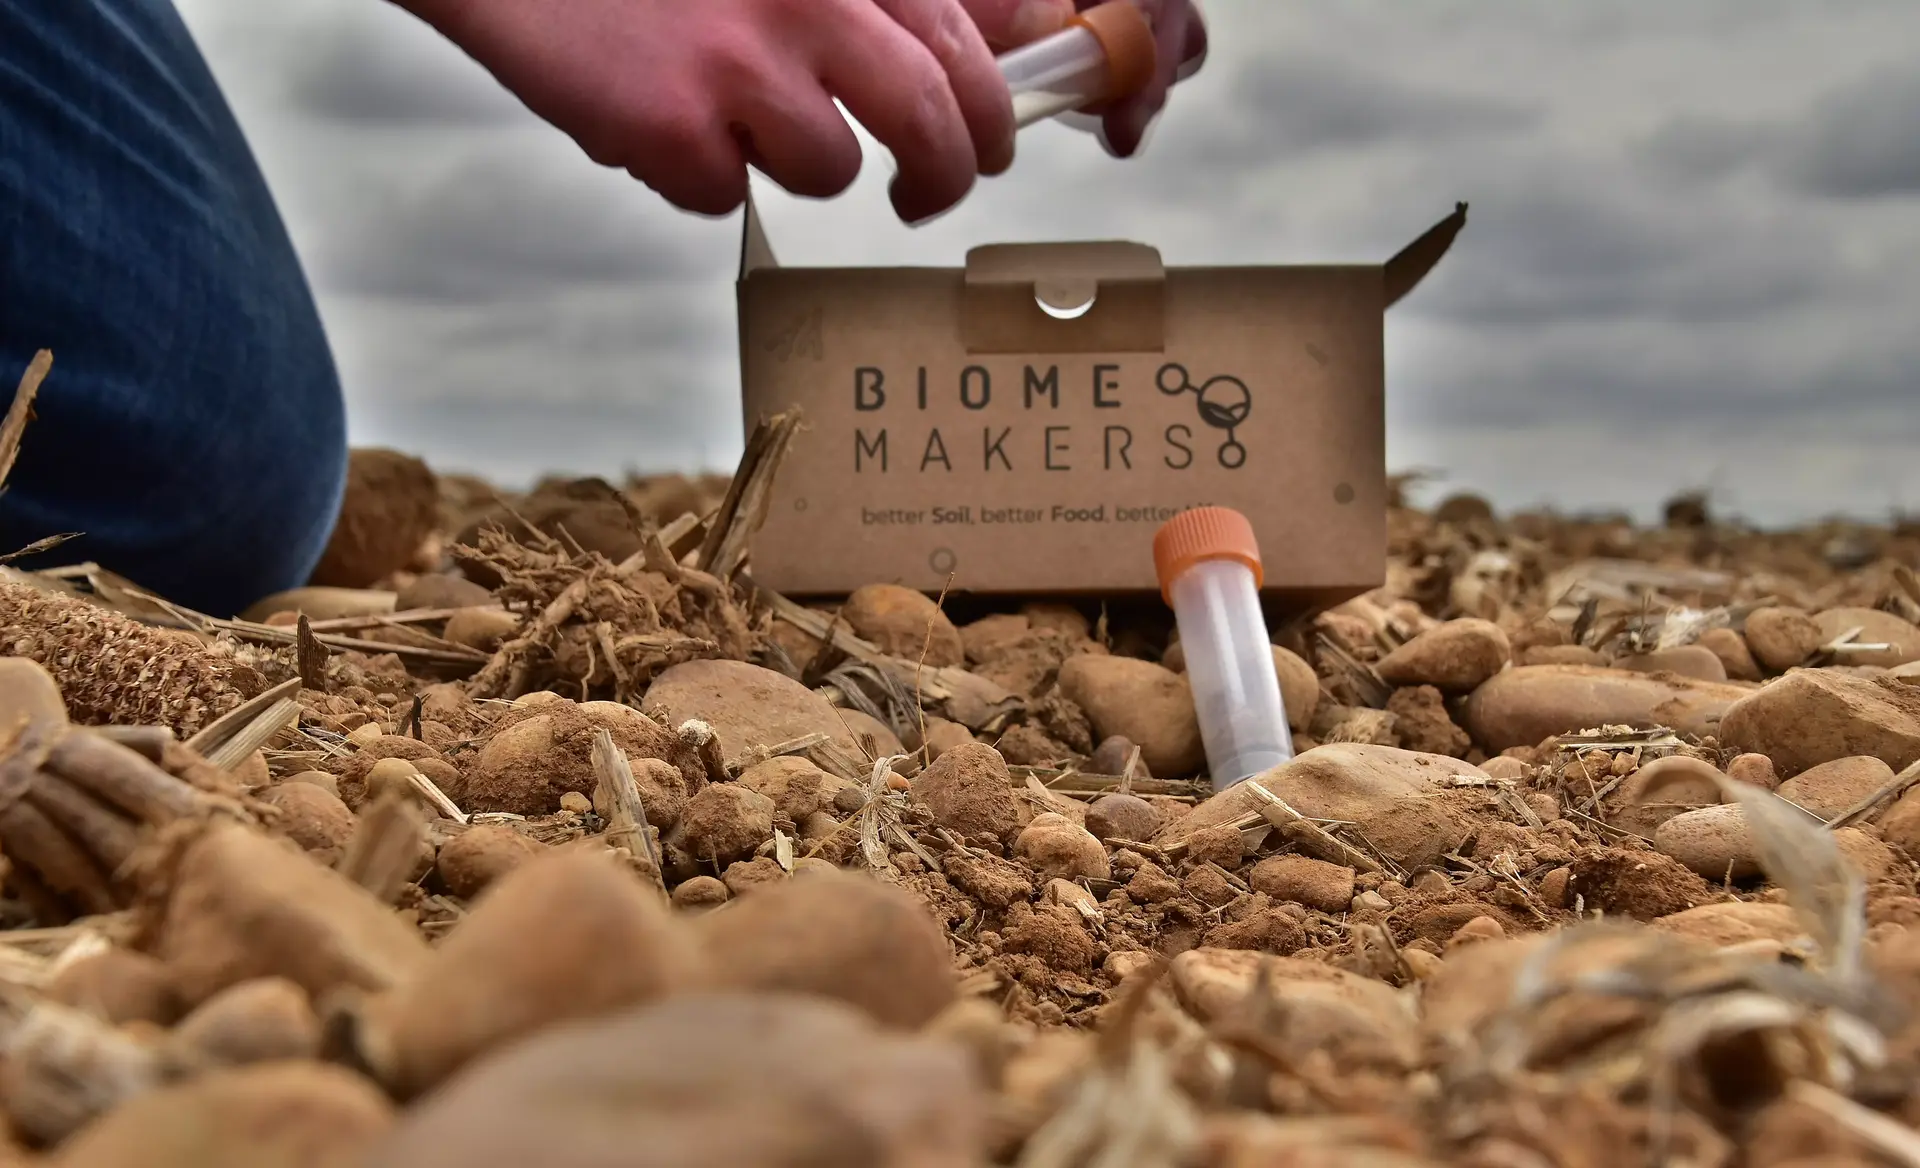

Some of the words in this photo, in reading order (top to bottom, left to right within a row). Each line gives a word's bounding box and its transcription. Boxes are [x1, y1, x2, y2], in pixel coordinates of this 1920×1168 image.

[855, 364, 1121, 411] BIOME
[854, 424, 1194, 473] MAKERS
[862, 507, 925, 524] better
[932, 506, 975, 525] Soil,
[980, 505, 1044, 523] better
[1051, 504, 1110, 523] Food,
